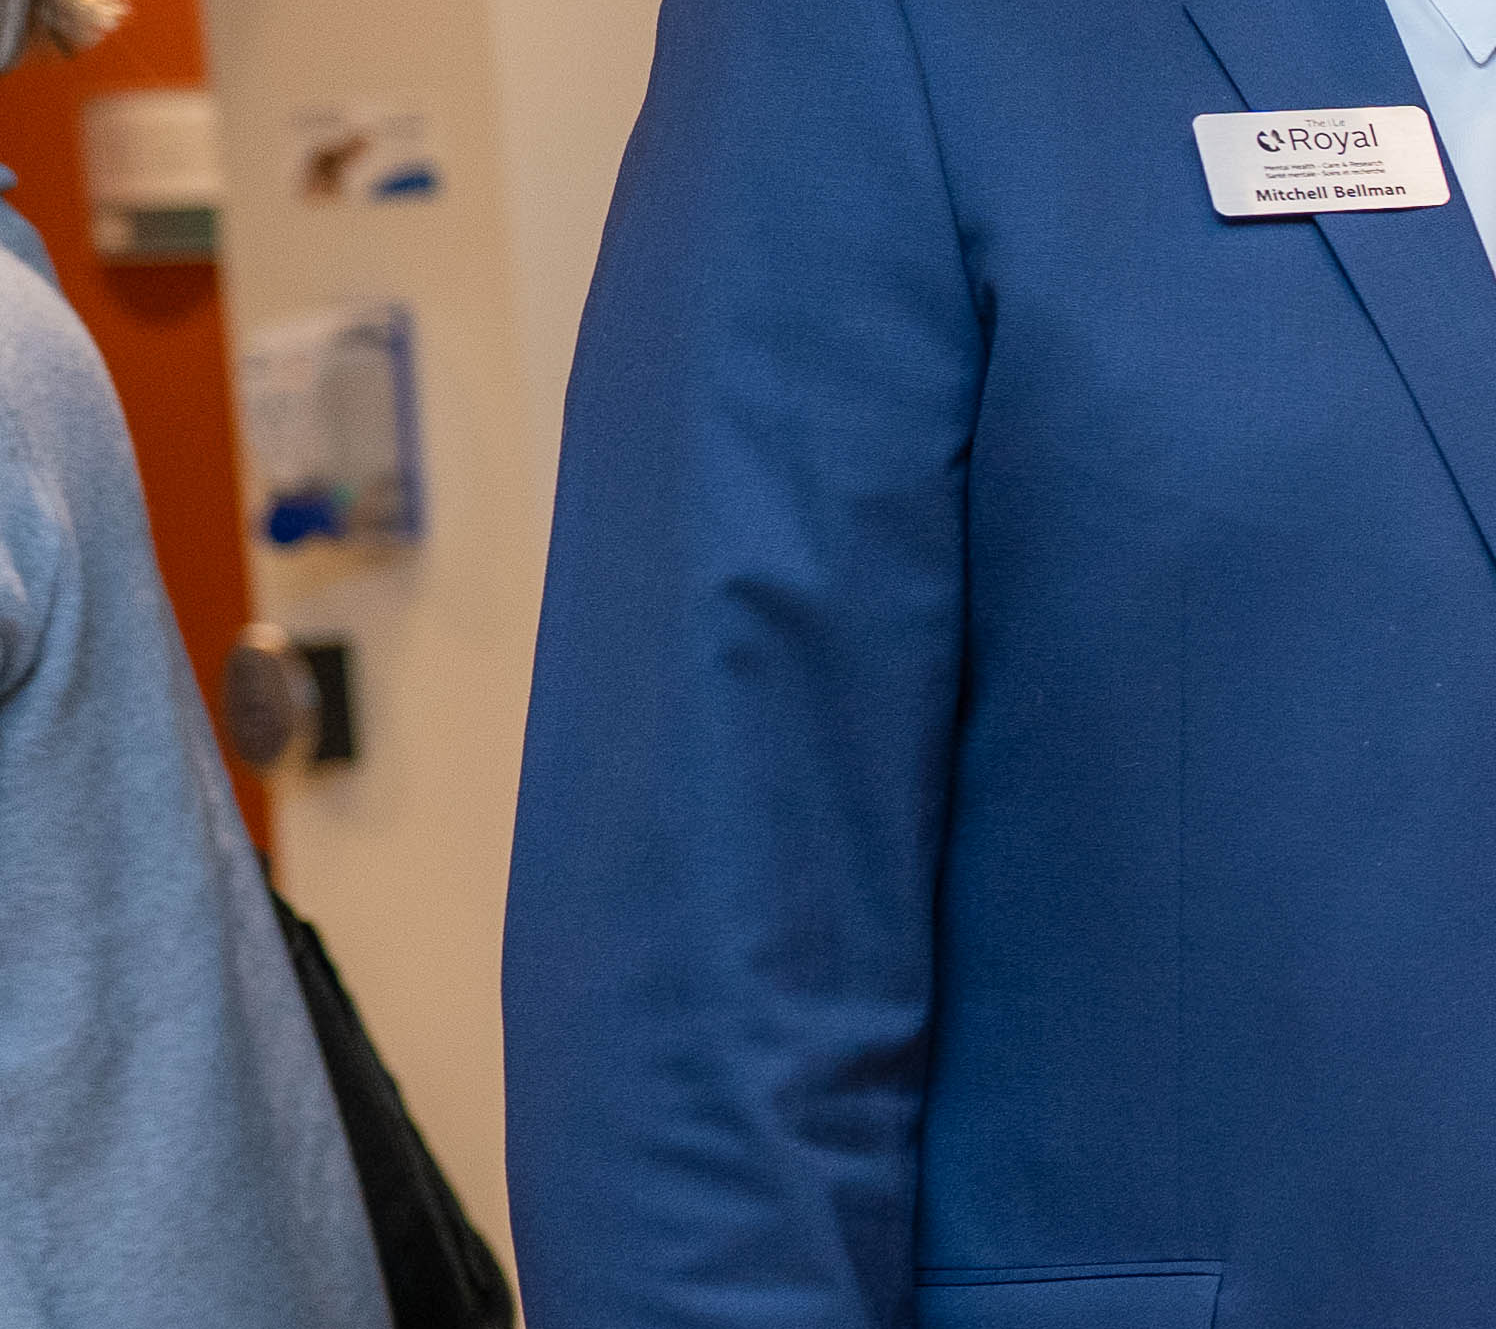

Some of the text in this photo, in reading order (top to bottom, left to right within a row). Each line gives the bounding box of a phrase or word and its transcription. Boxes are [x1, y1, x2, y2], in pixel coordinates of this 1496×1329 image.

[1306, 119, 1325, 127] The
[1288, 123, 1379, 155] Royal
[1256, 184, 1407, 202] Mitchell Bellman
